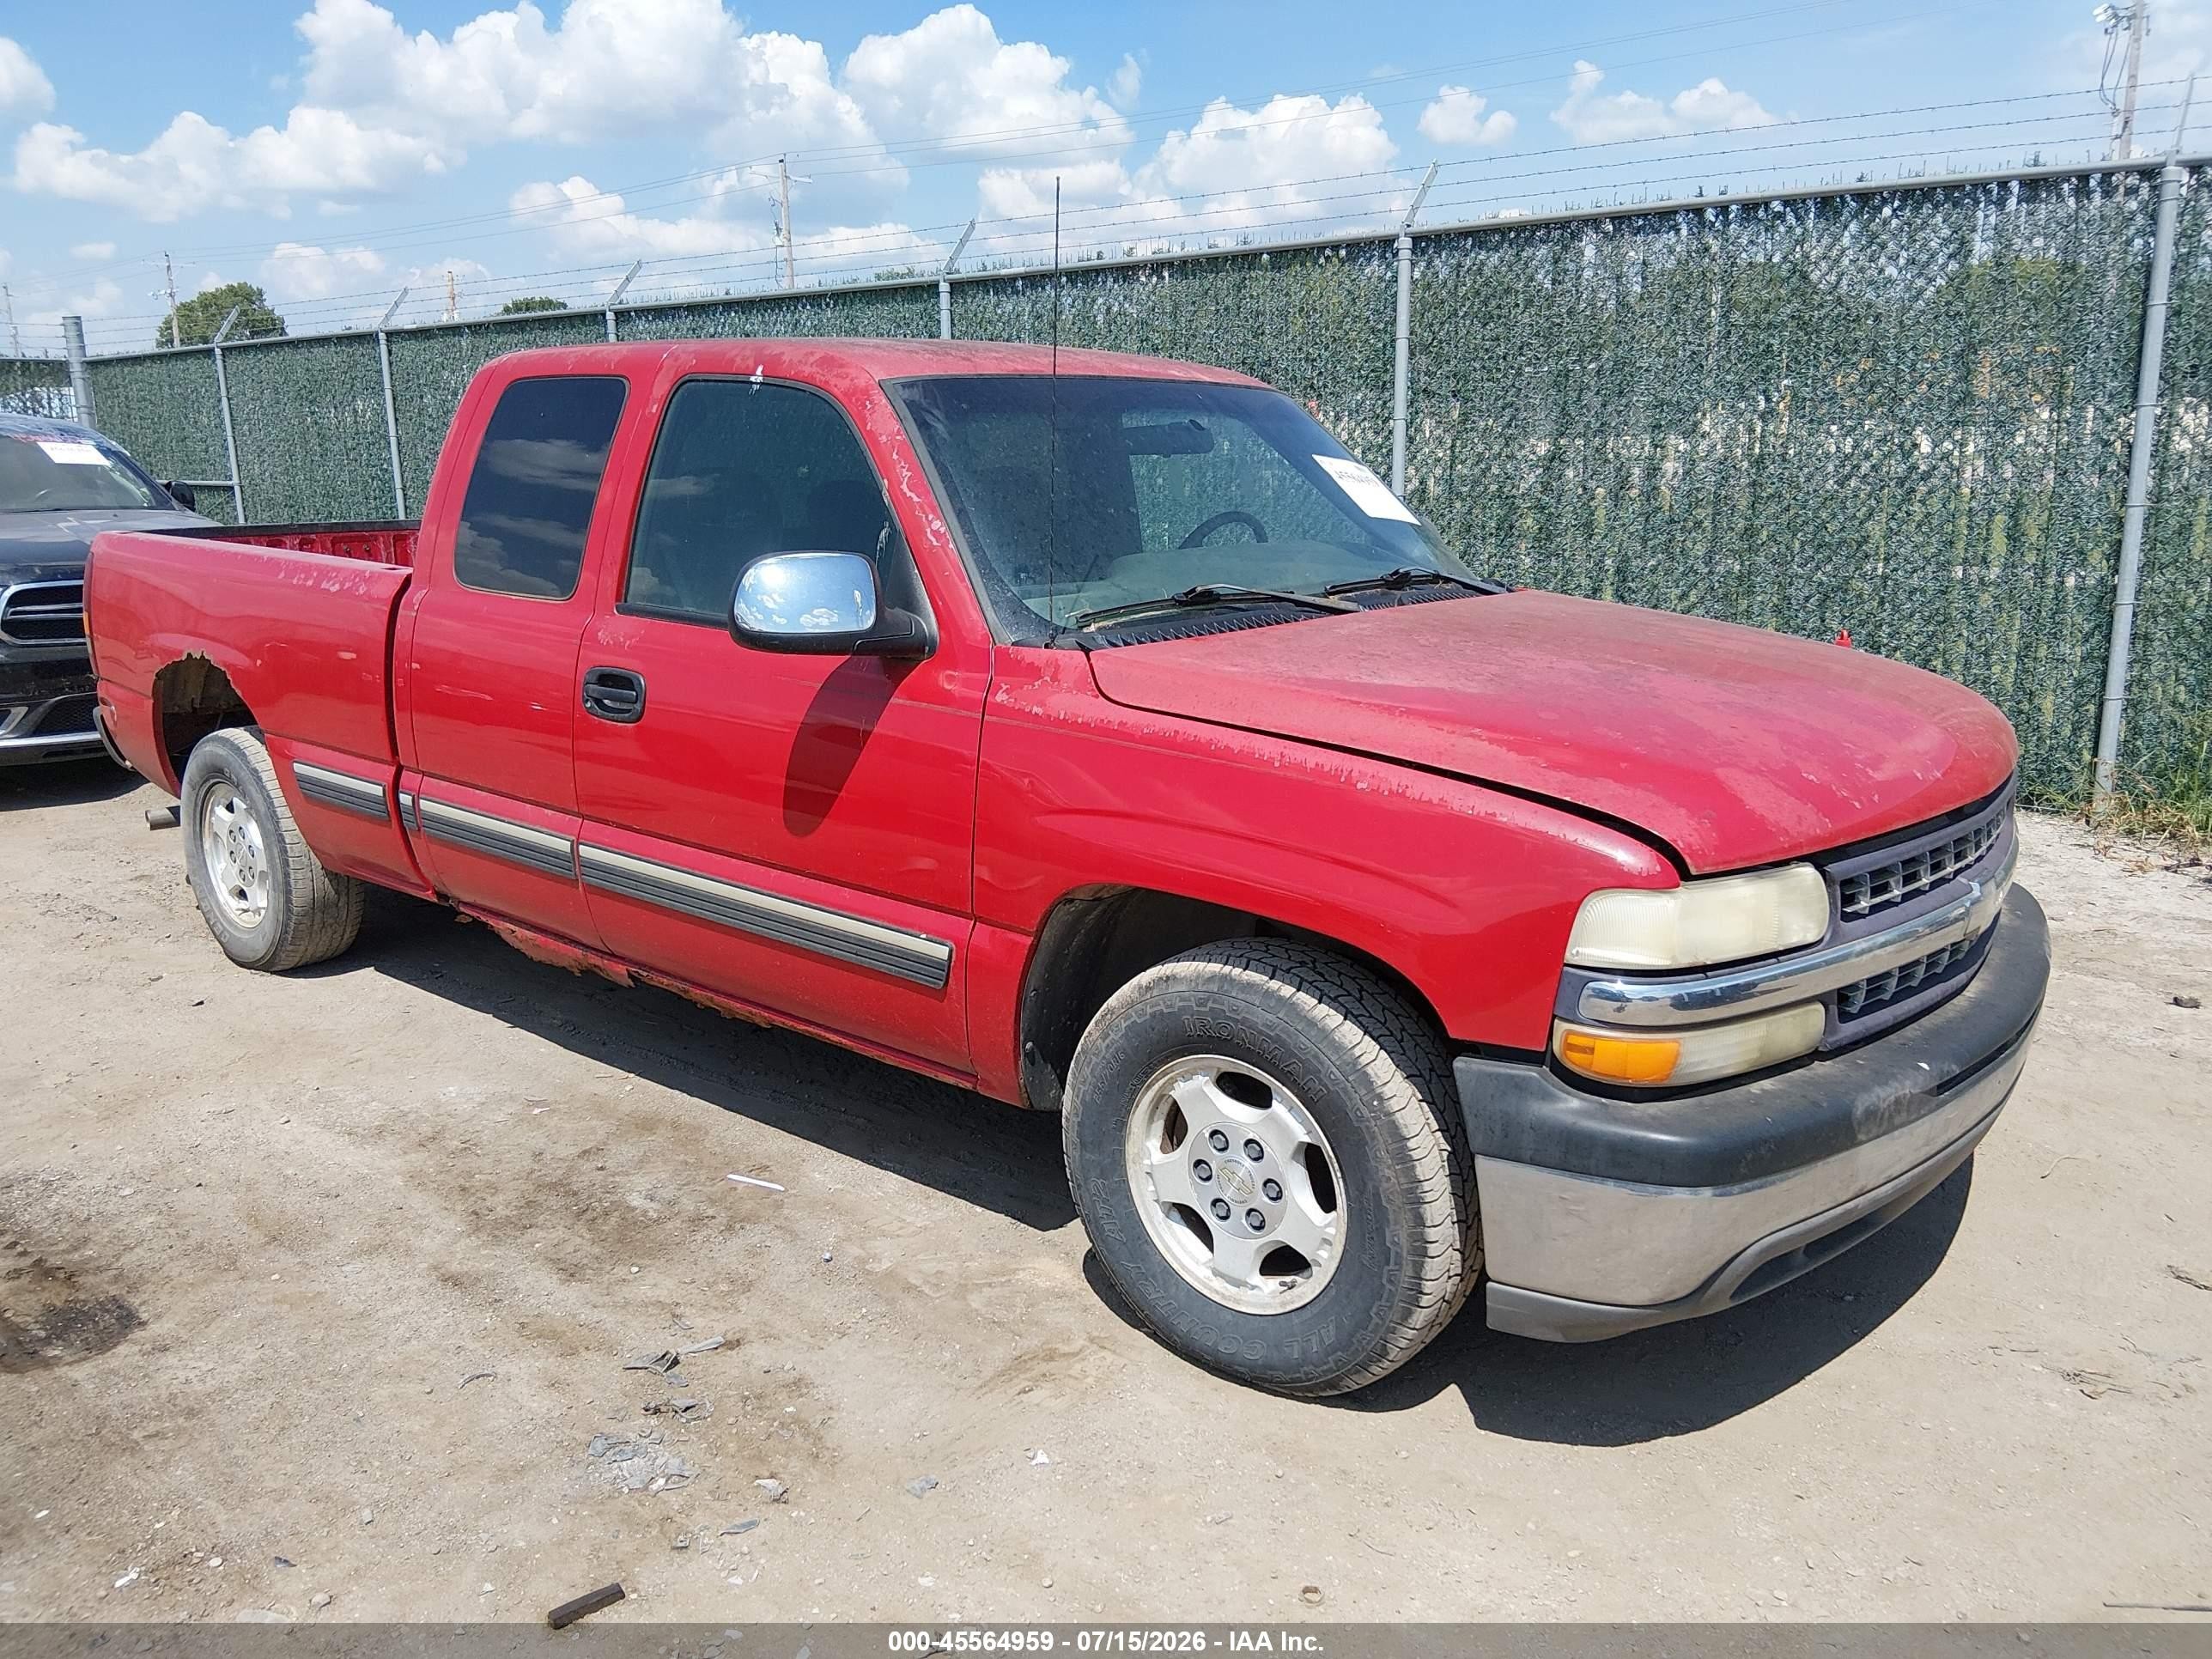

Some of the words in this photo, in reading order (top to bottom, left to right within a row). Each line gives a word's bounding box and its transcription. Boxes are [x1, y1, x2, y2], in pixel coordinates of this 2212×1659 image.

[1182, 1016, 1328, 1104] IRONMAN
[1119, 1260, 1267, 1361] COUNTRY
[1284, 1316, 1336, 1360] ALL
